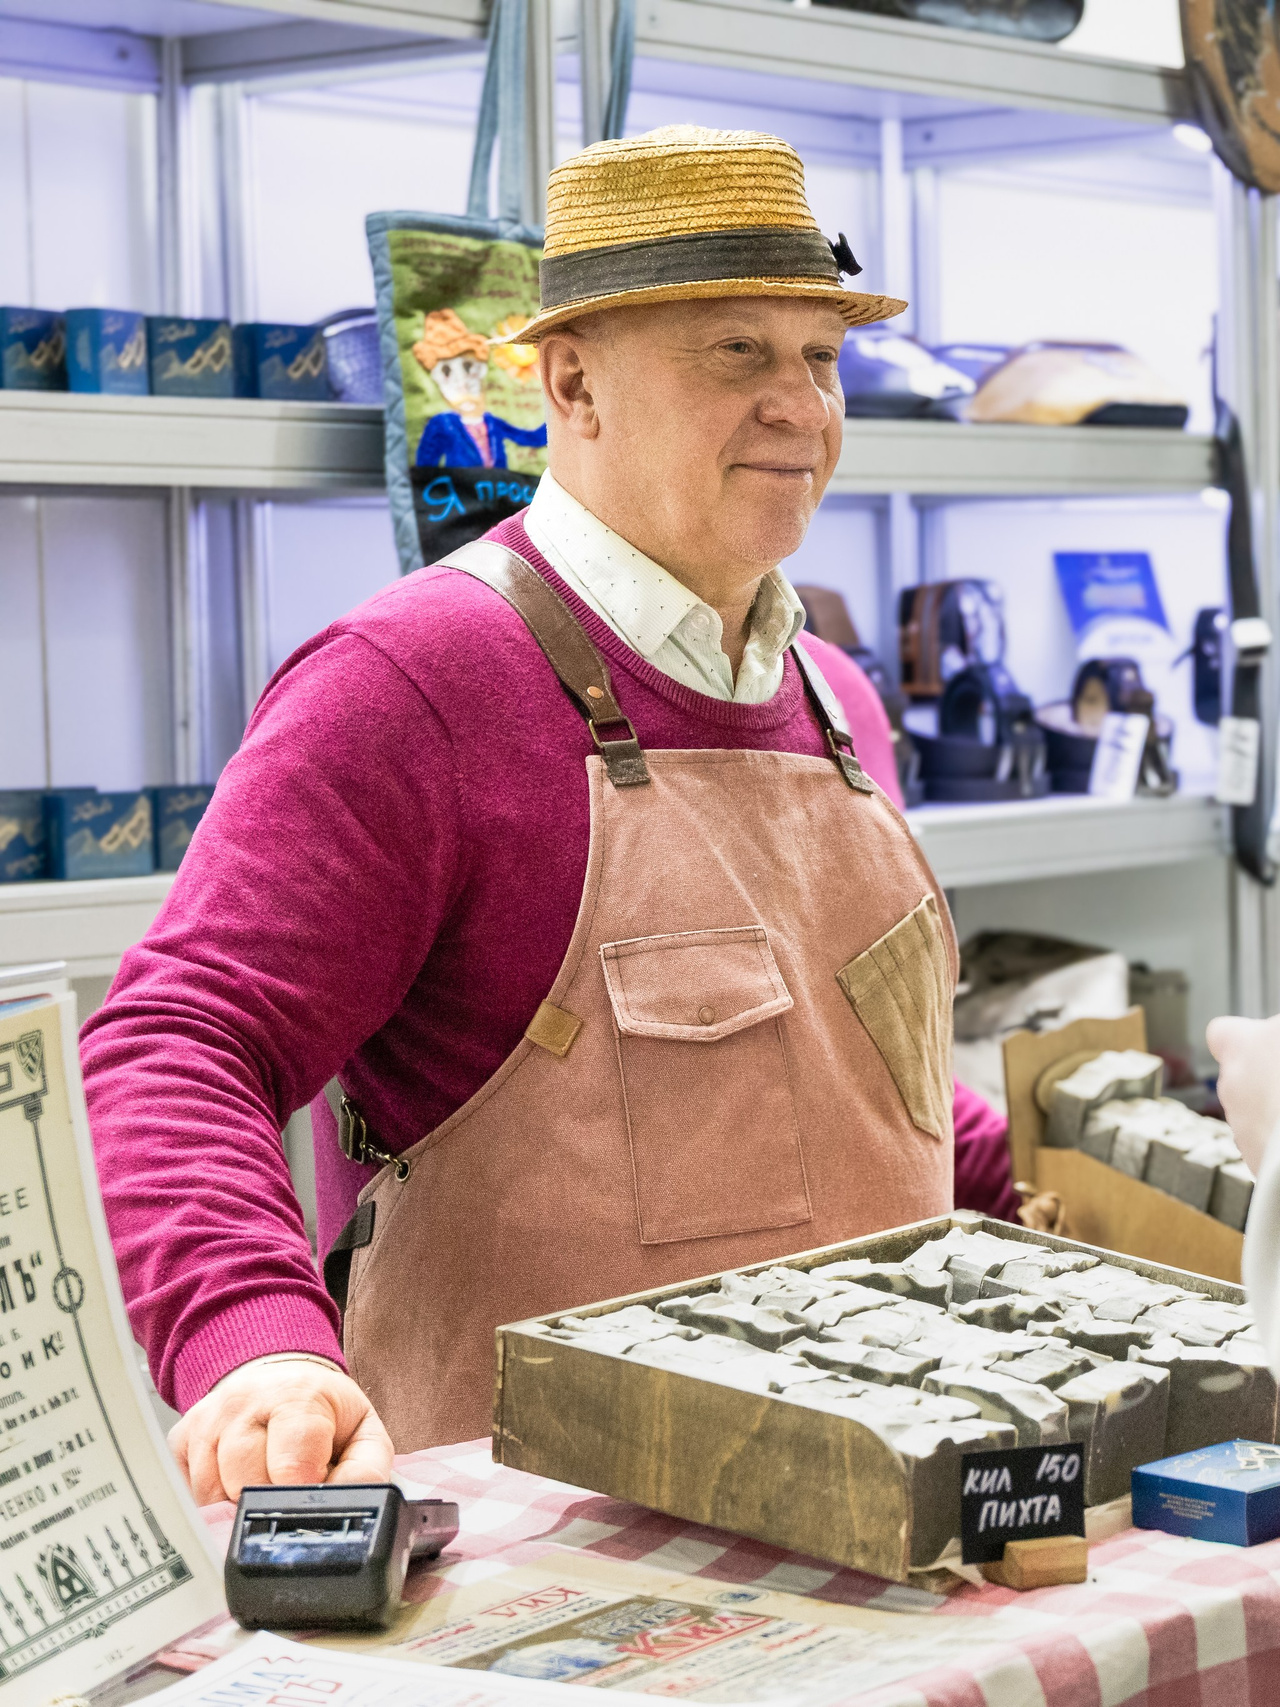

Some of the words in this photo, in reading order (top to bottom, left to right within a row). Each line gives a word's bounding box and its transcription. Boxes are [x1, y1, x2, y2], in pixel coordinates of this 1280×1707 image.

[422, 475, 466, 522] Я
[963, 1467, 1012, 1496] КИЛ
[1035, 1453, 1080, 1483] 150
[978, 1494, 1061, 1533] ПИХТА
